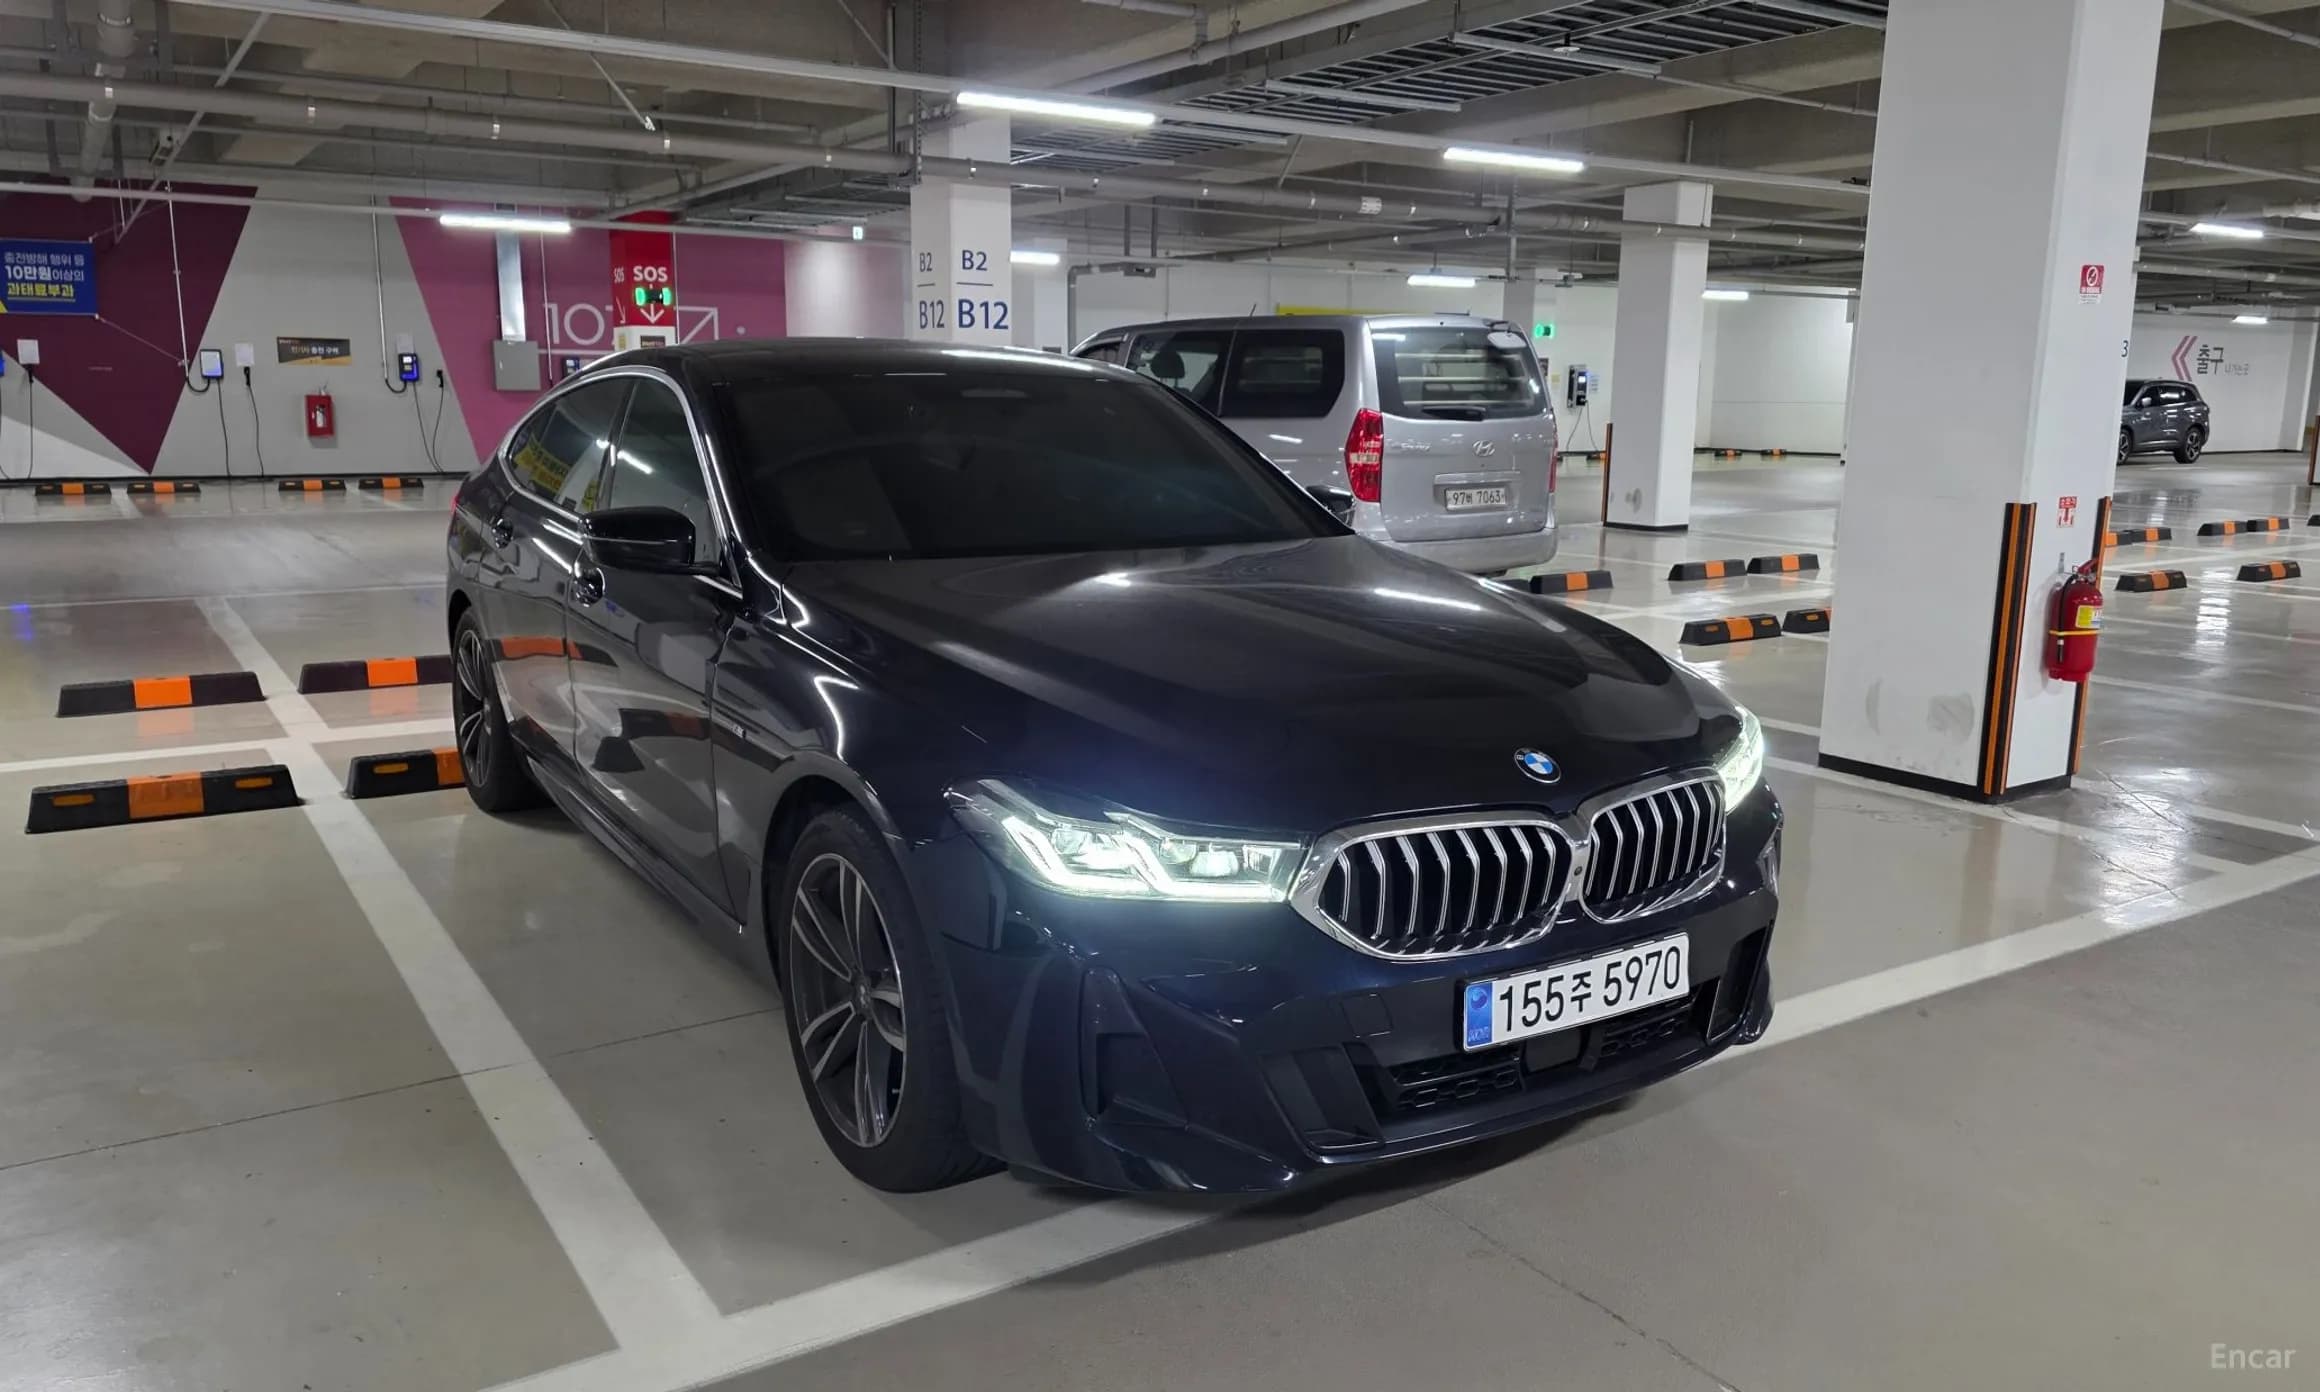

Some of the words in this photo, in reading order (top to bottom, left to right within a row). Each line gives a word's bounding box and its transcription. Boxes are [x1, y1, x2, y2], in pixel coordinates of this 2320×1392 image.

[919, 251, 933, 273] B2
[961, 249, 988, 272] B2
[614, 266, 625, 283] SOS
[633, 265, 668, 282] SOS
[7, 282, 75, 297] 과태료부과
[919, 299, 945, 330] B12
[958, 298, 1009, 330] B12
[2121, 340, 2129, 357] 3
[2197, 344, 2224, 375] 출구
[1476, 489, 1501, 504] 7063
[1500, 971, 1592, 1032] 155주
[1603, 946, 1681, 1007] 5970
